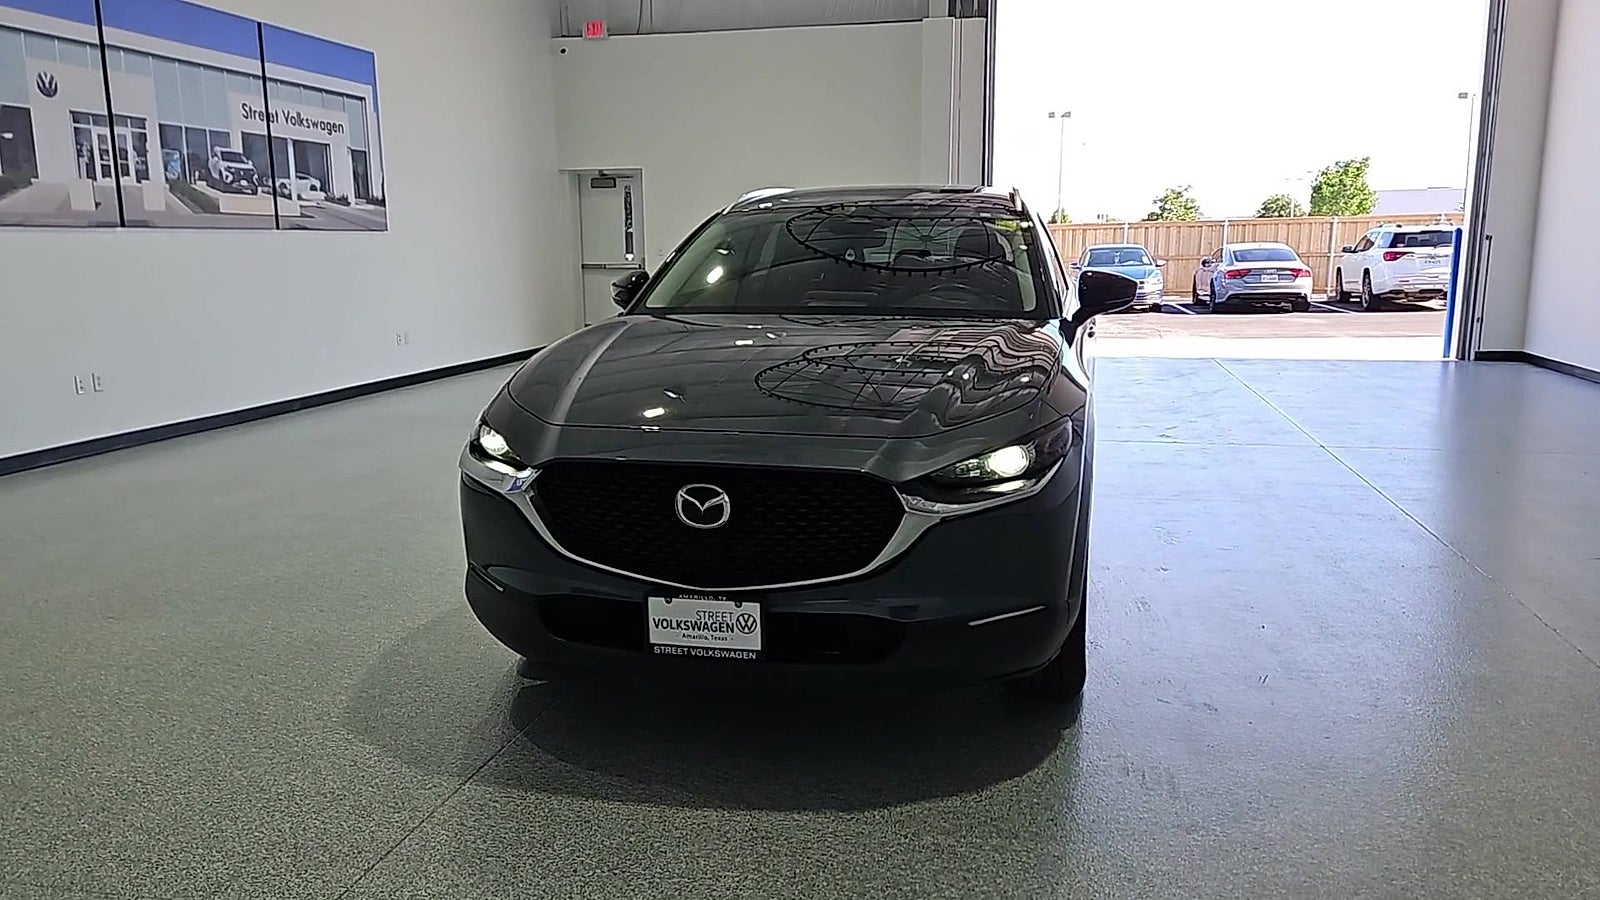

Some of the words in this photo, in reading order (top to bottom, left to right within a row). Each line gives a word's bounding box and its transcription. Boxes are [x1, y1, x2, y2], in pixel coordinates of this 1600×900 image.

[241, 102, 279, 124] Street
[281, 109, 345, 136] Volkswagen
[695, 610, 735, 623] STREET
[652, 617, 735, 634] VOLKSWAGEN
[653, 646, 689, 655] STREET
[690, 648, 757, 660] VOLKSWAGEN
